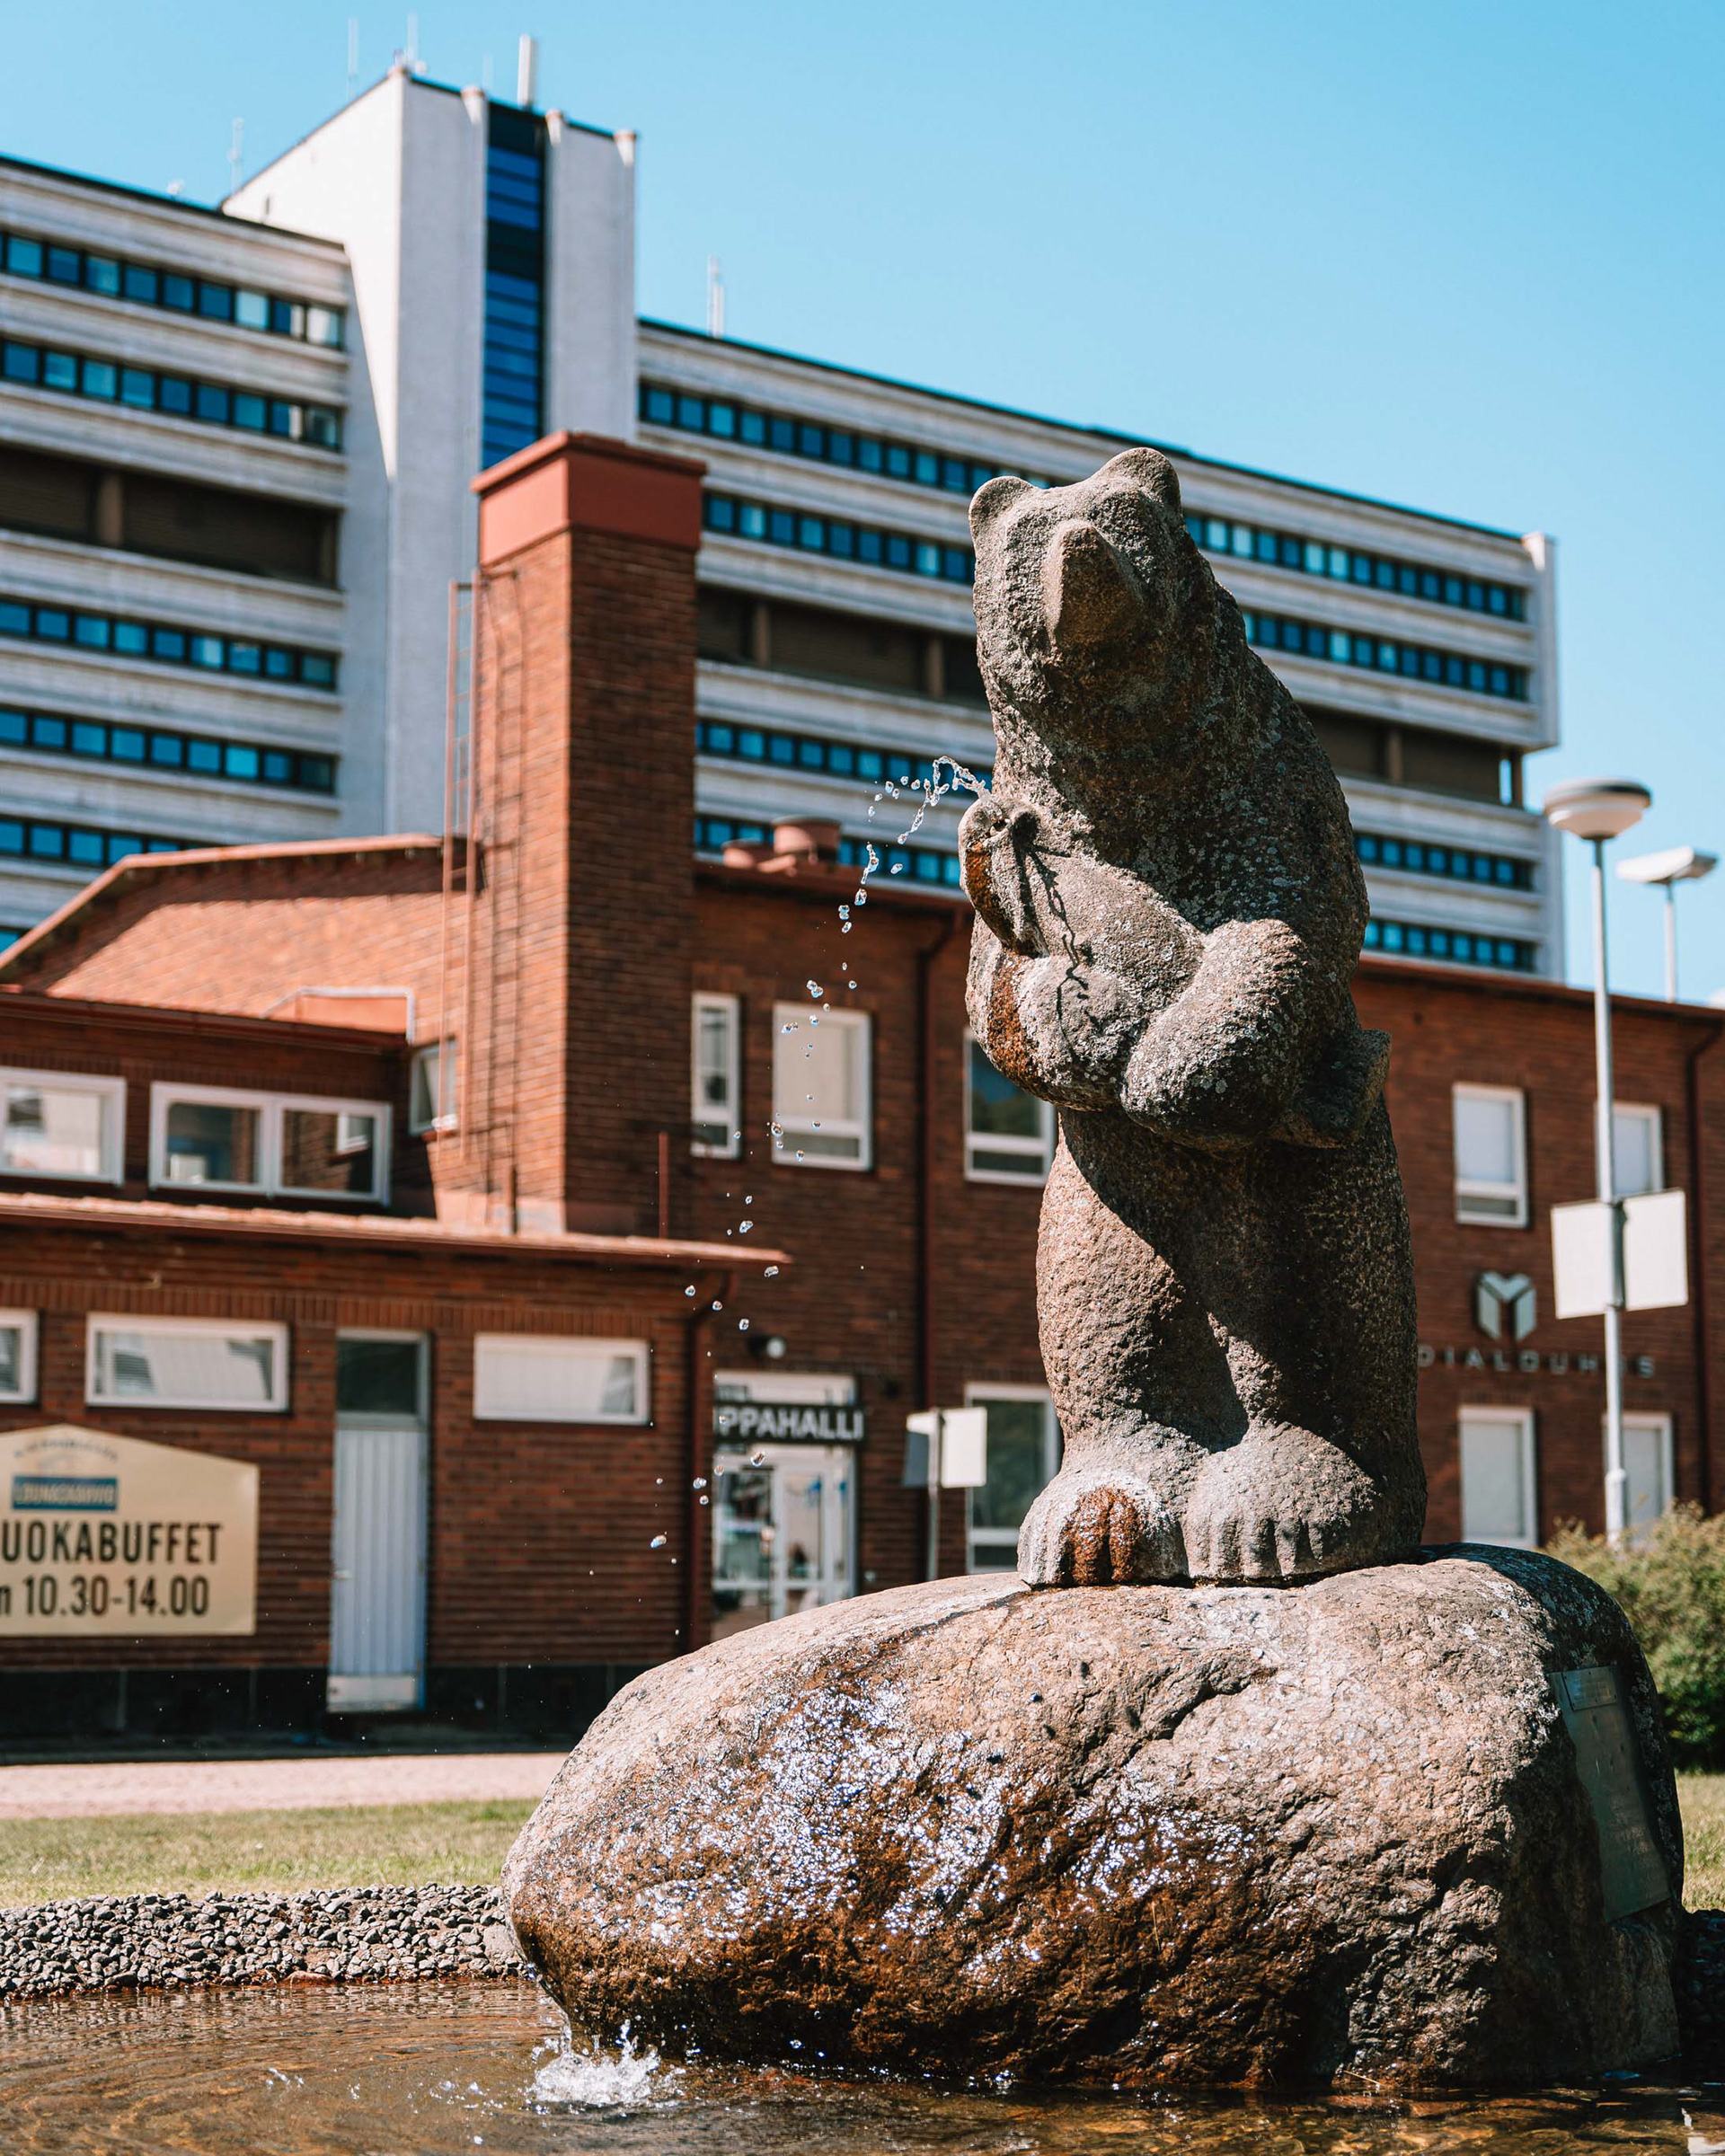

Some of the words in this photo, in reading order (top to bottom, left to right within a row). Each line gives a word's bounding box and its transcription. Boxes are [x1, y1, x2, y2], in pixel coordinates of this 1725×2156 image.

[718, 1405, 864, 1440] PPAHALLI
[2, 1520, 221, 1563] UOKABUFFET
[22, 1575, 209, 1616] 10.30-14.00
